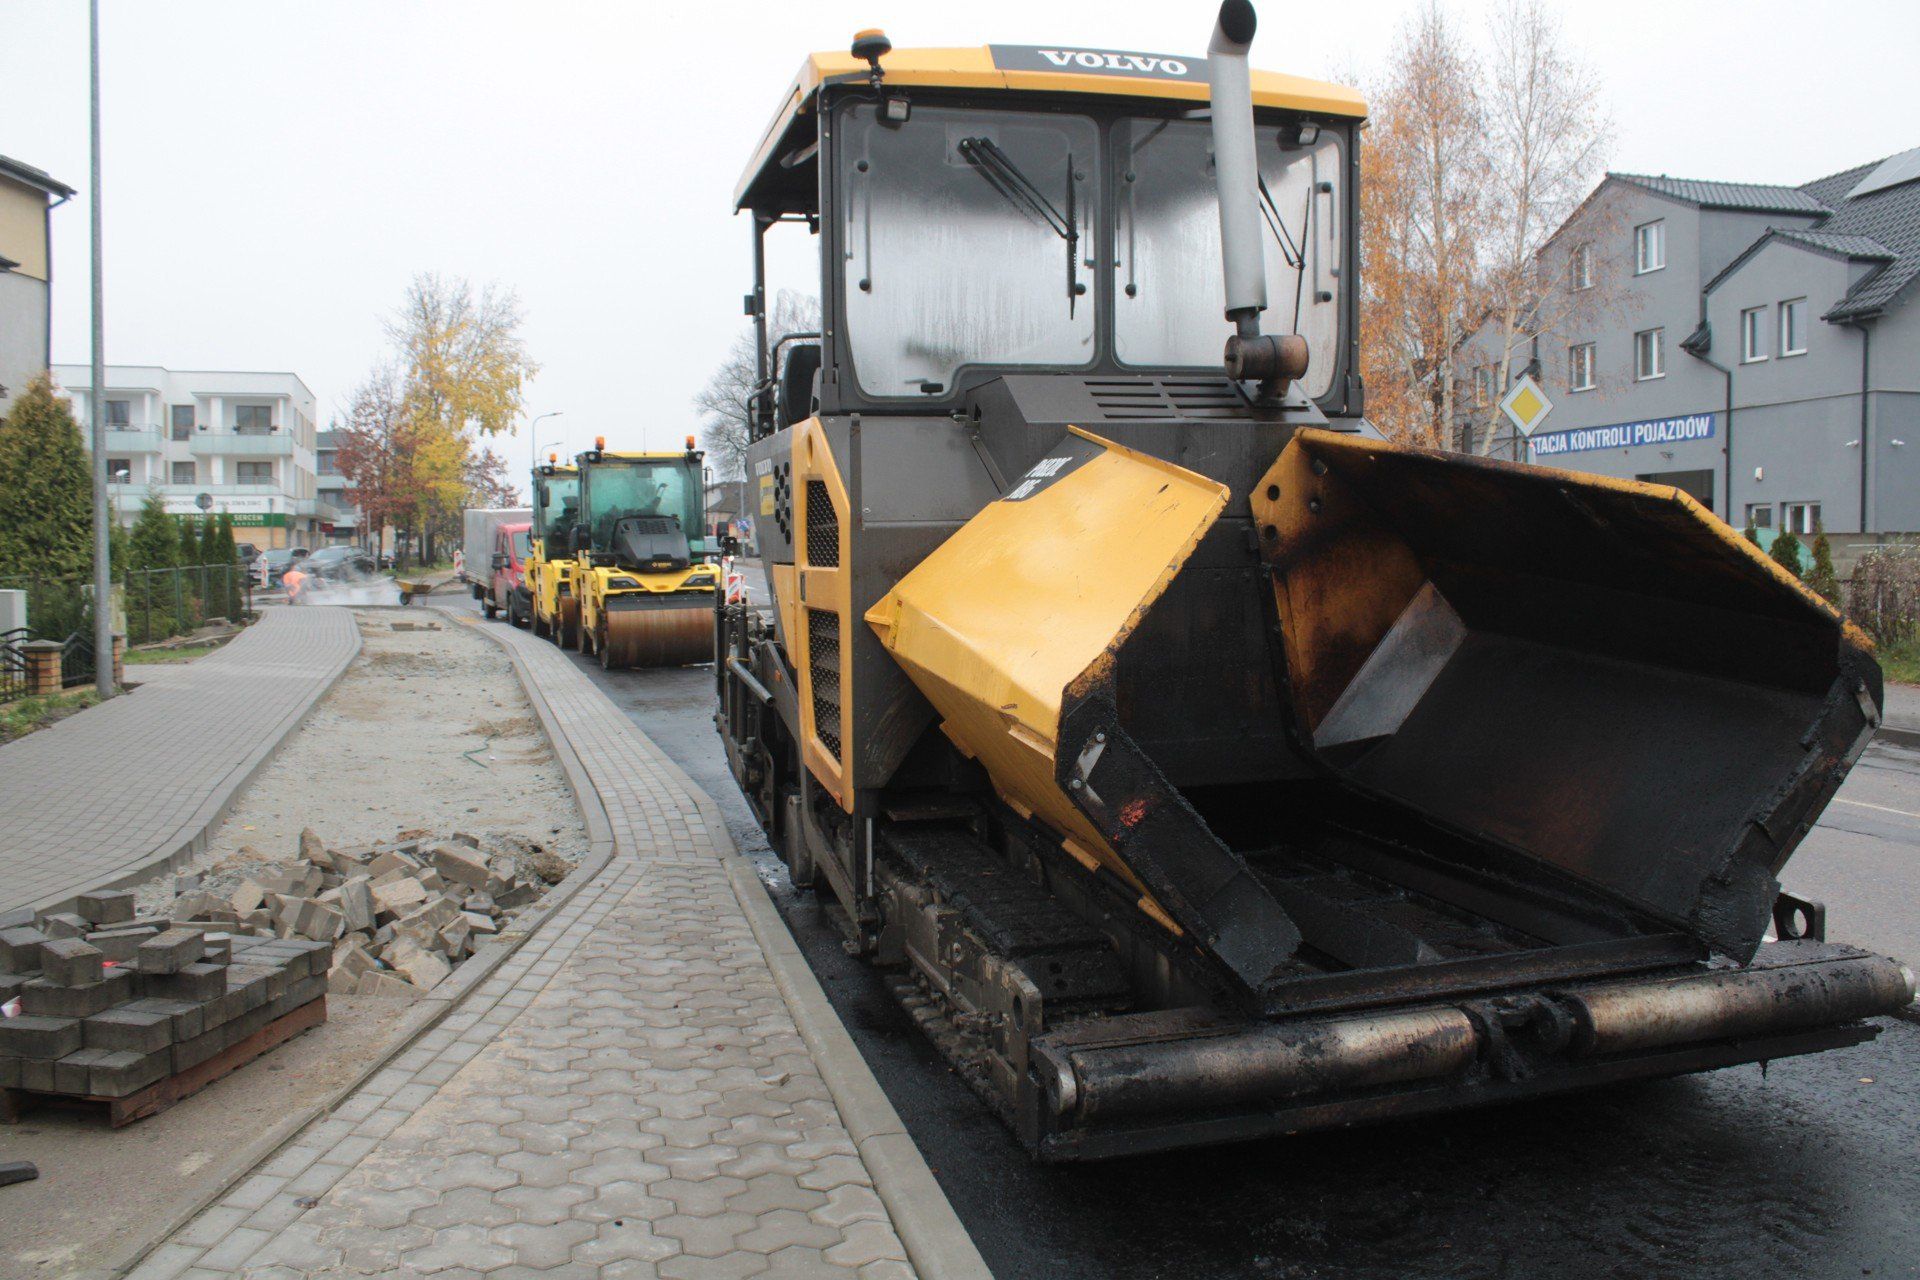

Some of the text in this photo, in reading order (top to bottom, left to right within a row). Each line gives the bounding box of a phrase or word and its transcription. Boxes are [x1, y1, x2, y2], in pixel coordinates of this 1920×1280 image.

[1038, 50, 1188, 75] VOLVO
[1571, 426, 1631, 449] KONTROLI
[1635, 416, 1709, 443] POJAZDÓW
